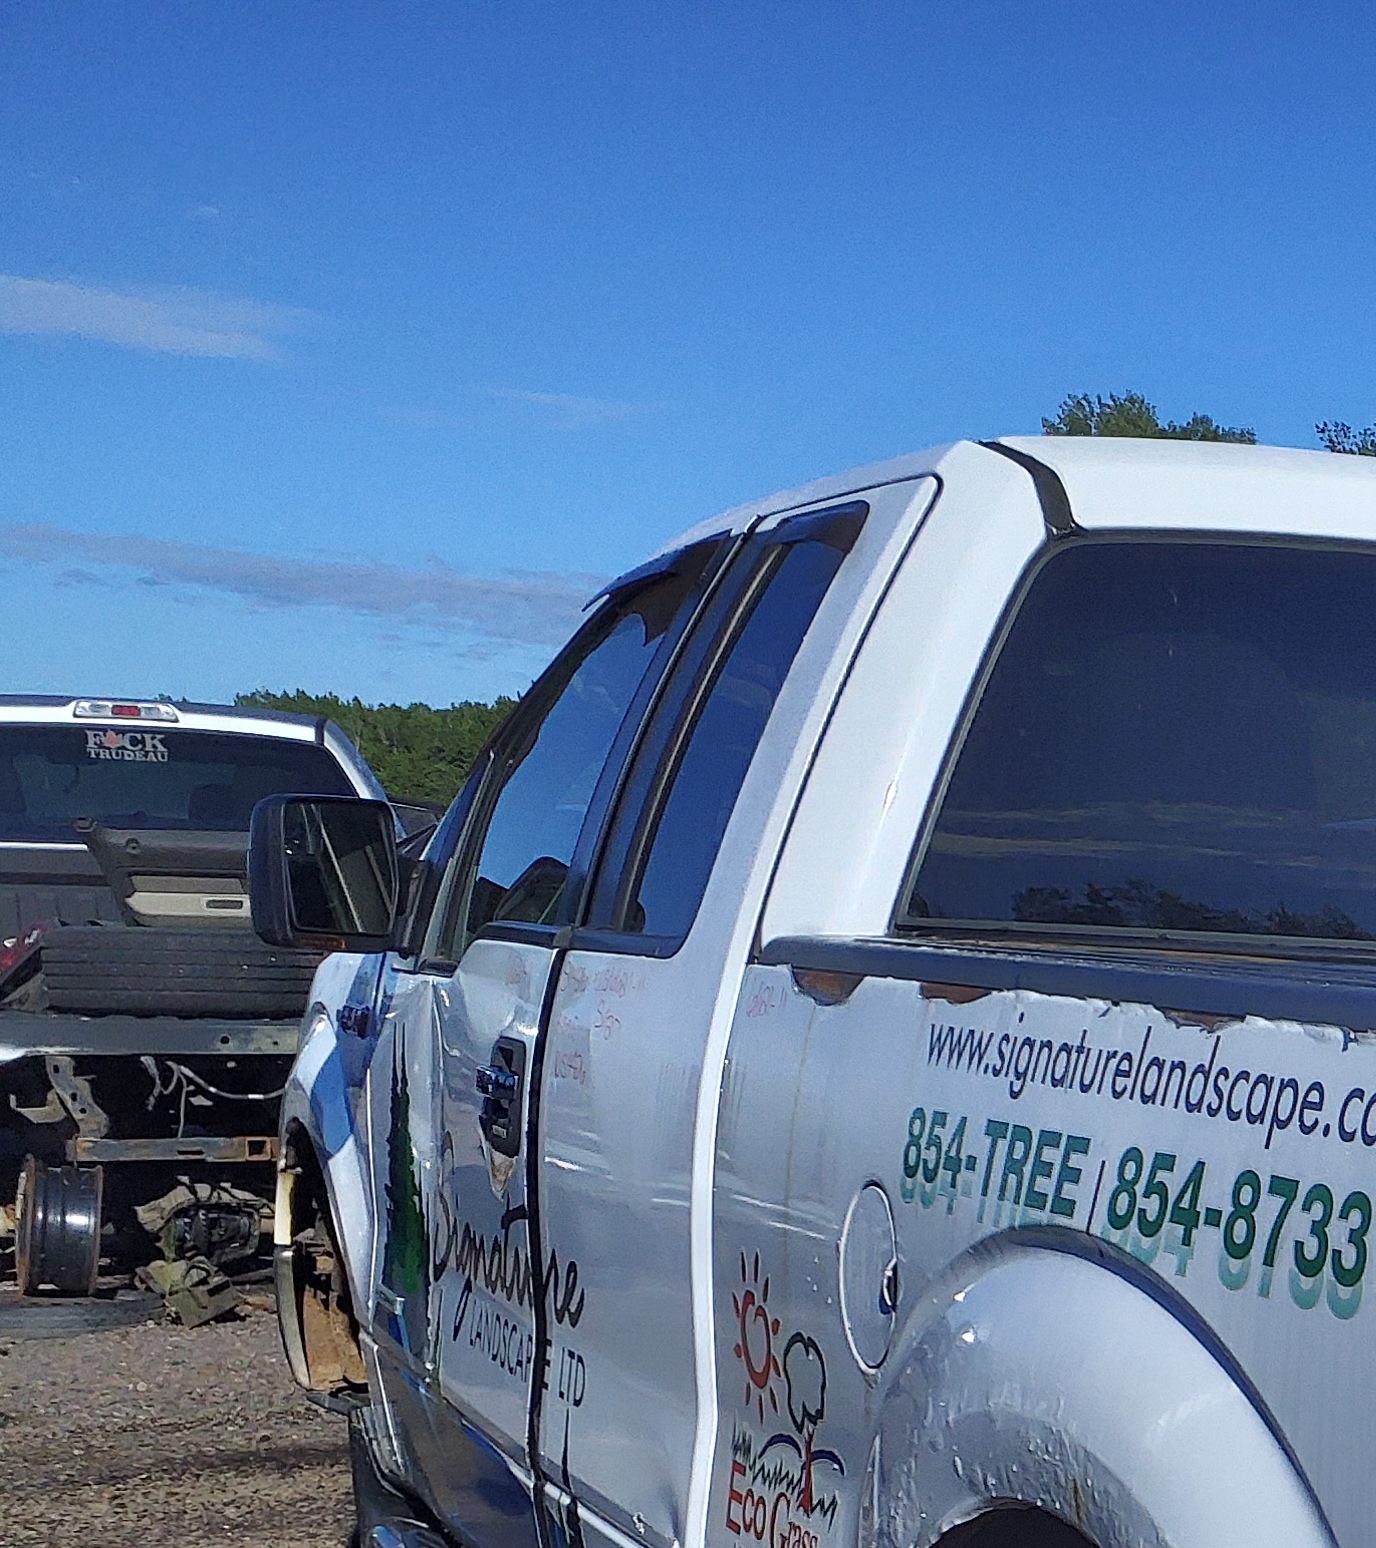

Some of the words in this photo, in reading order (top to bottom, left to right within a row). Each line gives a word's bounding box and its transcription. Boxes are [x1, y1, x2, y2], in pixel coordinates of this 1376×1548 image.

[85, 729, 168, 752] FCK
[86, 747, 168, 762] TRUDEAU
[434, 1130, 585, 1342] Signature
[902, 1106, 1092, 1218] 854-TREE
[1106, 1145, 1373, 1287] 854-8733
[468, 1298, 553, 1392] LANDSCAPE
[558, 1345, 587, 1408] LTD
[726, 1460, 767, 1541] Eco
